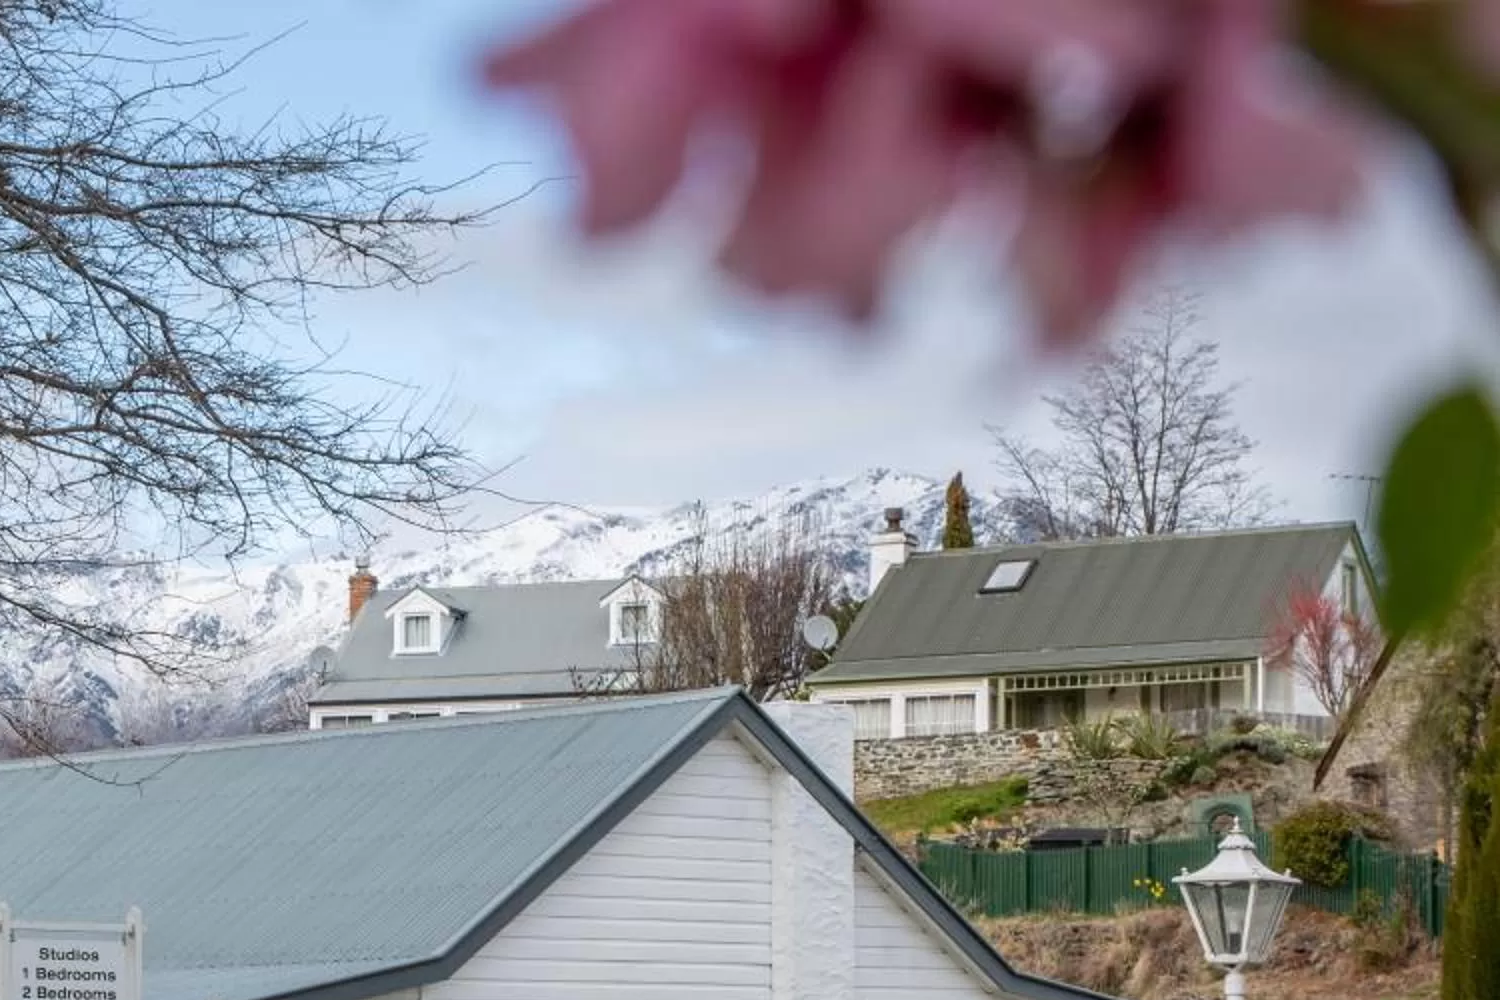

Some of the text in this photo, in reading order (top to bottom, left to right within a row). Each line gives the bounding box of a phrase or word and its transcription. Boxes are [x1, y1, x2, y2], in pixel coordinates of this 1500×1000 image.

[38, 947, 100, 962] Studios
[22, 967, 117, 982] 1 Bedrooms
[22, 986, 117, 1000] 2 Bedrooms
